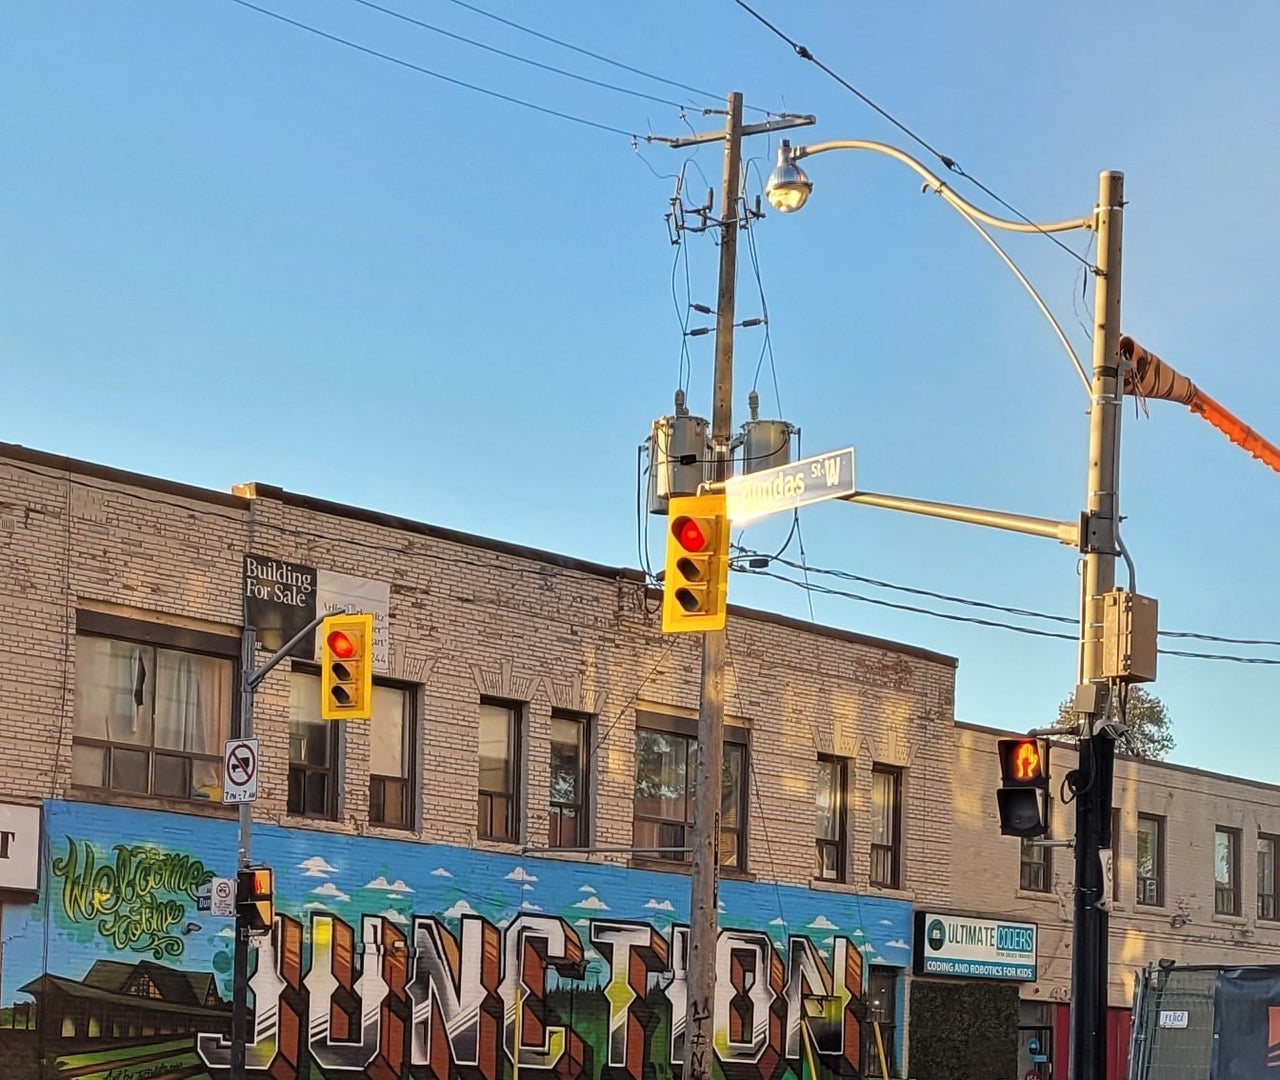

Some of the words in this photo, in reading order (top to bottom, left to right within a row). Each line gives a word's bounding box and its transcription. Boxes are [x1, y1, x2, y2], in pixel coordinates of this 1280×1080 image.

[824, 456, 841, 487] W
[245, 558, 312, 591] Building
[245, 578, 271, 600] For
[273, 585, 306, 608] Sale
[53, 835, 217, 924] Welcome
[947, 923, 995, 947] ULTIMATE
[997, 927, 1033, 951] CODERS
[927, 961, 954, 973] CODING
[954, 963, 969, 974] AND
[970, 964, 1002, 976] ROBOTICS
[1003, 966, 1017, 977] FOR
[1017, 967, 1032, 978] KIDS
